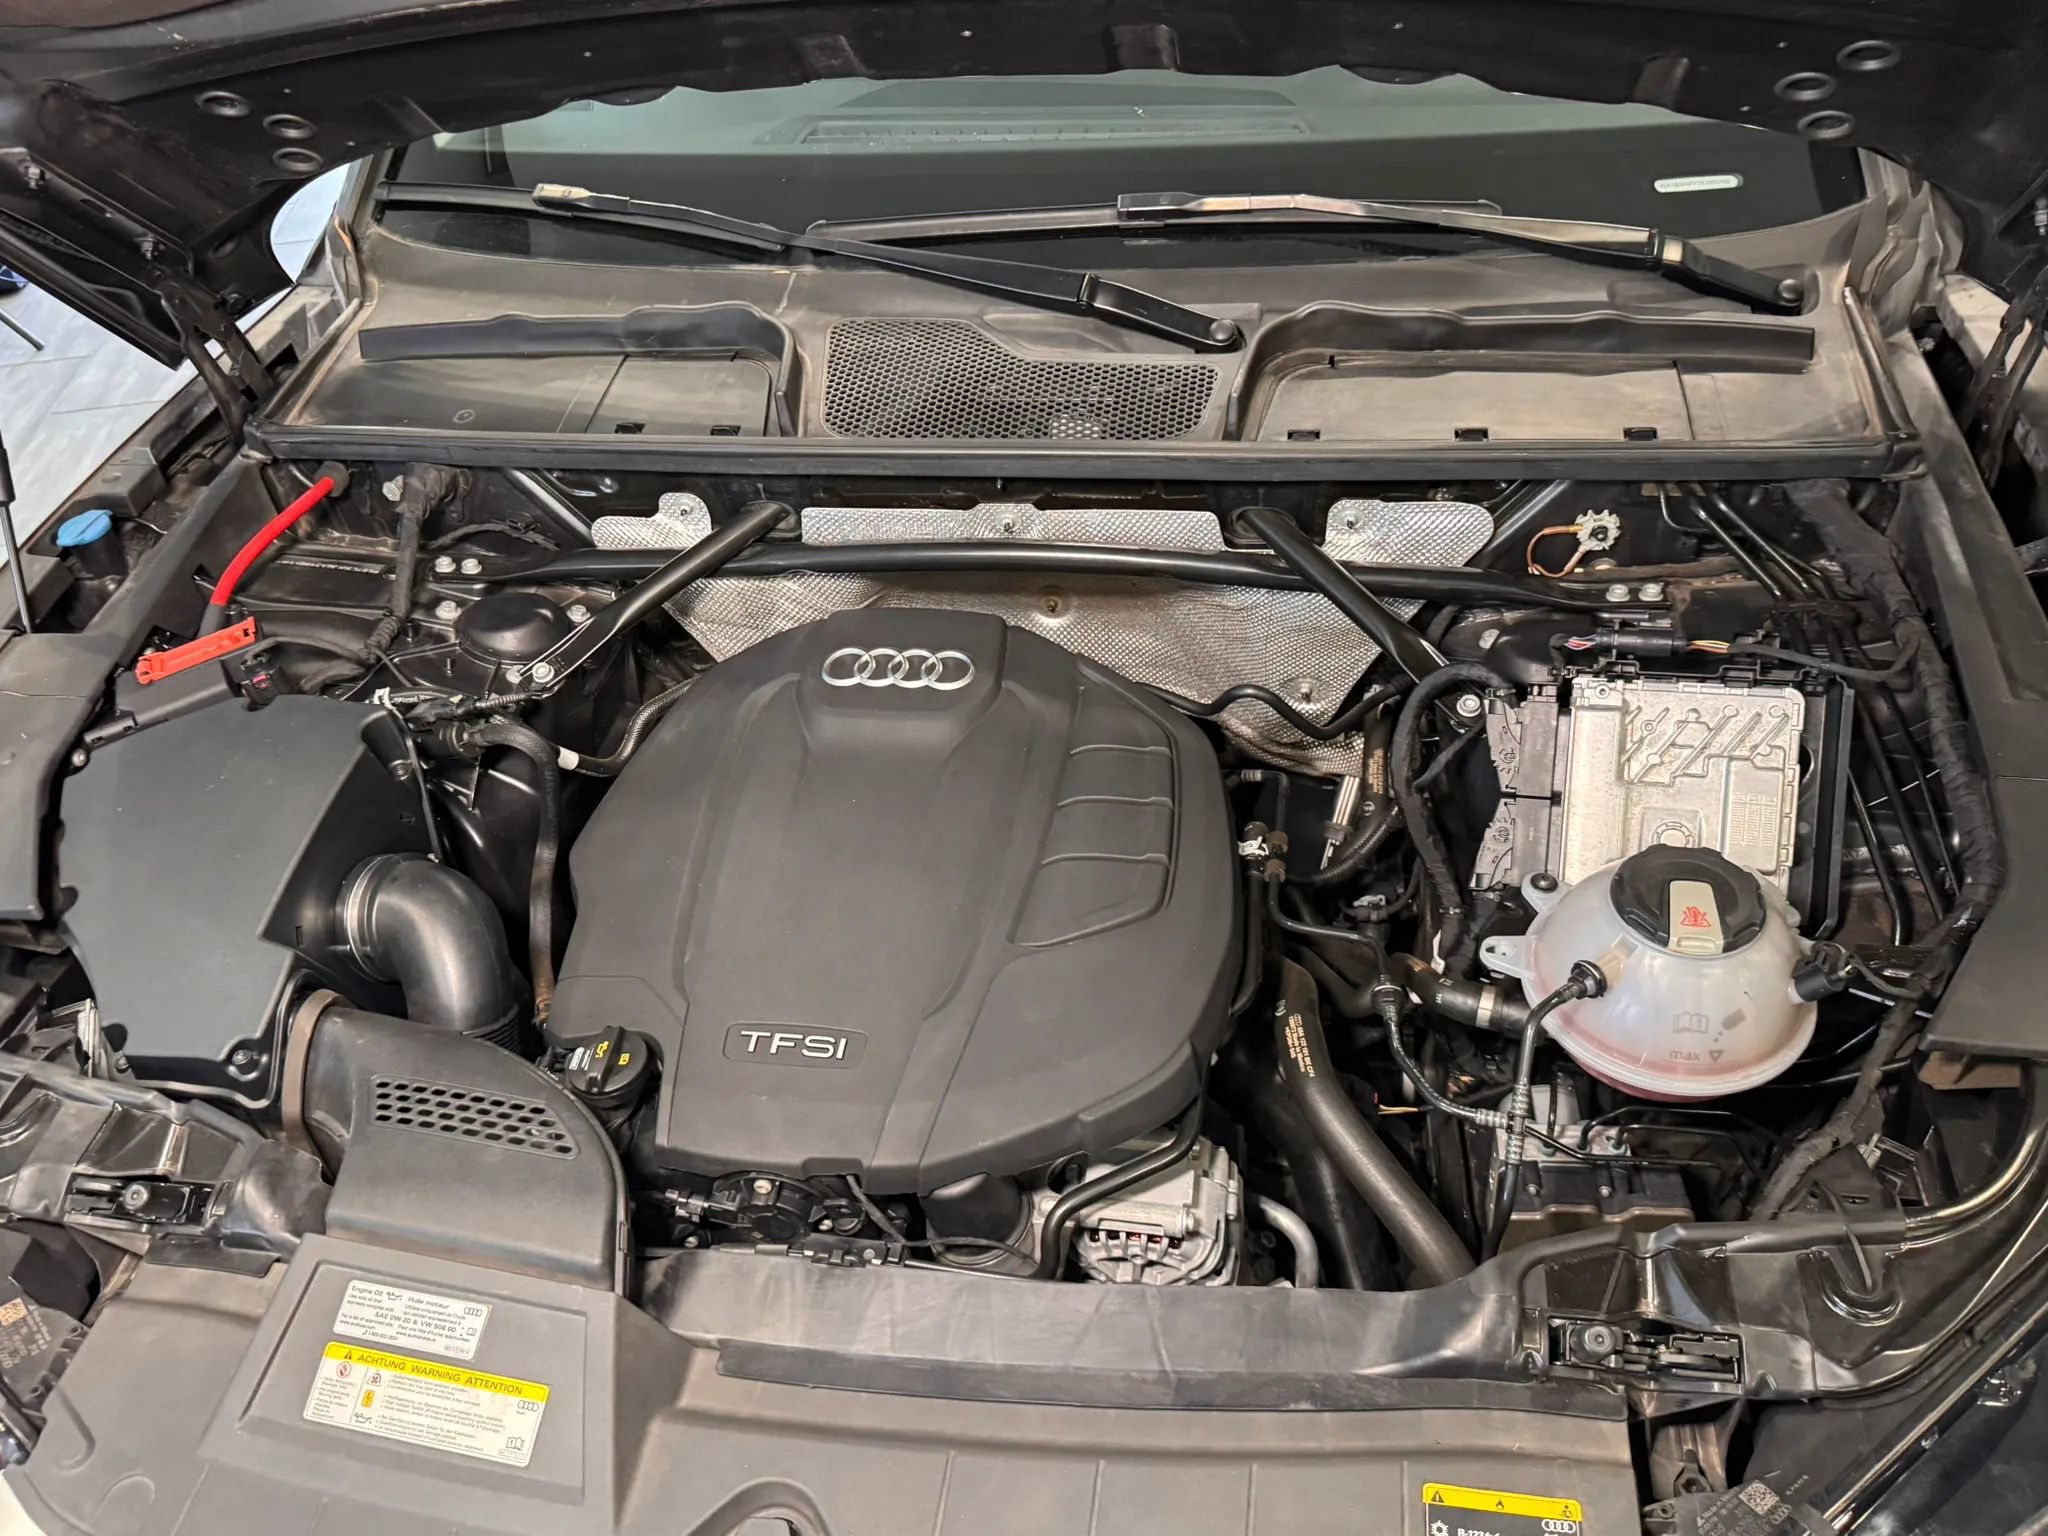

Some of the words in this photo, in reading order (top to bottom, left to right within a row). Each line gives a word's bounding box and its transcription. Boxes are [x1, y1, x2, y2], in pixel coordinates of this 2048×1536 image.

[740, 1030, 848, 1060] TFSI
[1669, 1050, 1701, 1061] max
[351, 1285, 372, 1295] Engine
[407, 1296, 424, 1304] Huile
[426, 1301, 450, 1309] moteur
[356, 1354, 406, 1370] ACHTUNG
[410, 1365, 460, 1382] WARNING
[464, 1376, 523, 1395] ATTENTION
